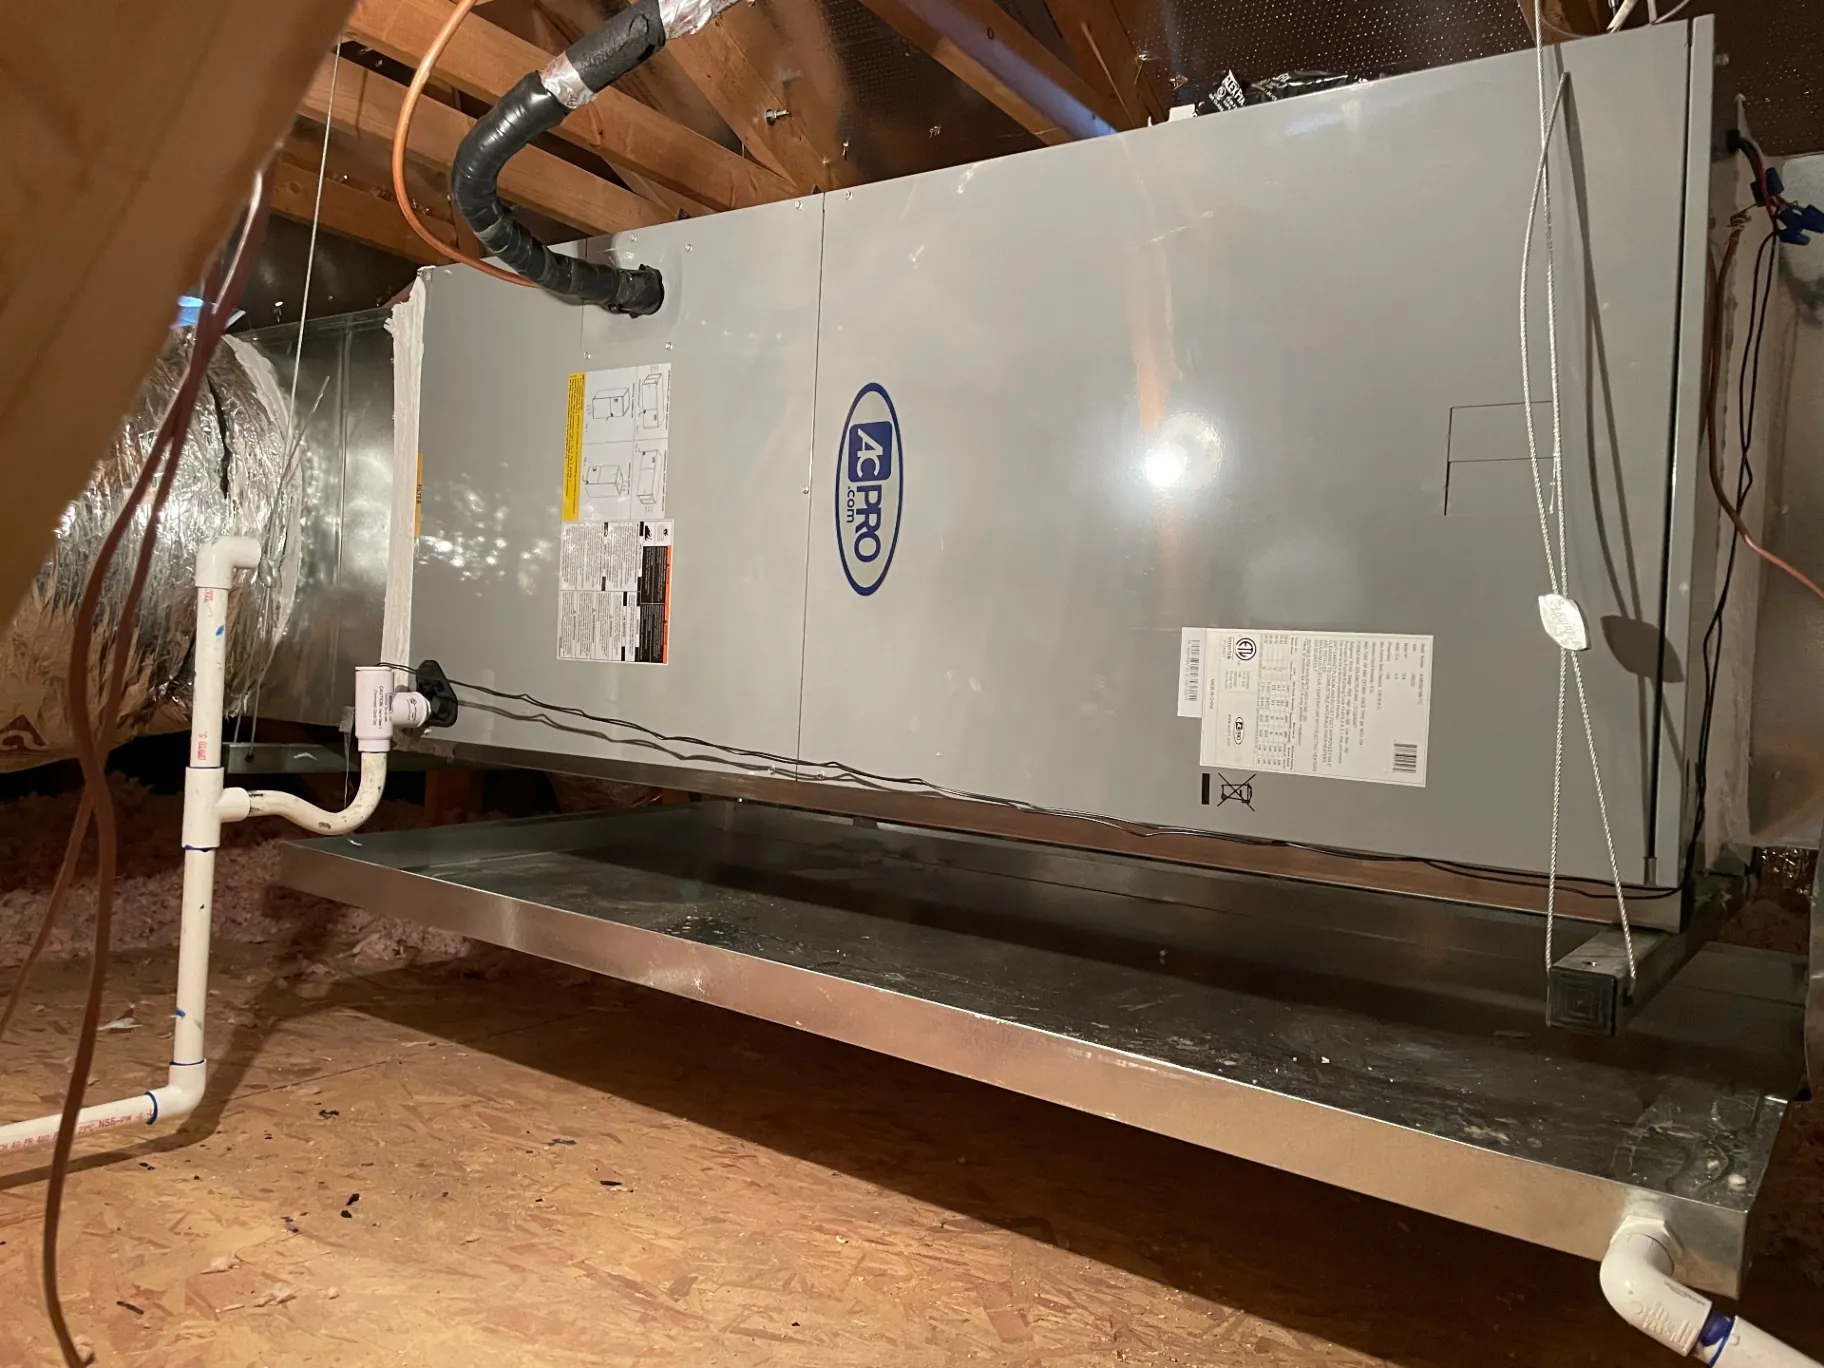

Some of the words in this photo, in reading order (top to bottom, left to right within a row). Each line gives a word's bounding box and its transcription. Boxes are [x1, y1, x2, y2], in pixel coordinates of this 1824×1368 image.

[856, 428, 884, 478] AC
[846, 486, 857, 523] .com
[854, 484, 883, 563] PRO
